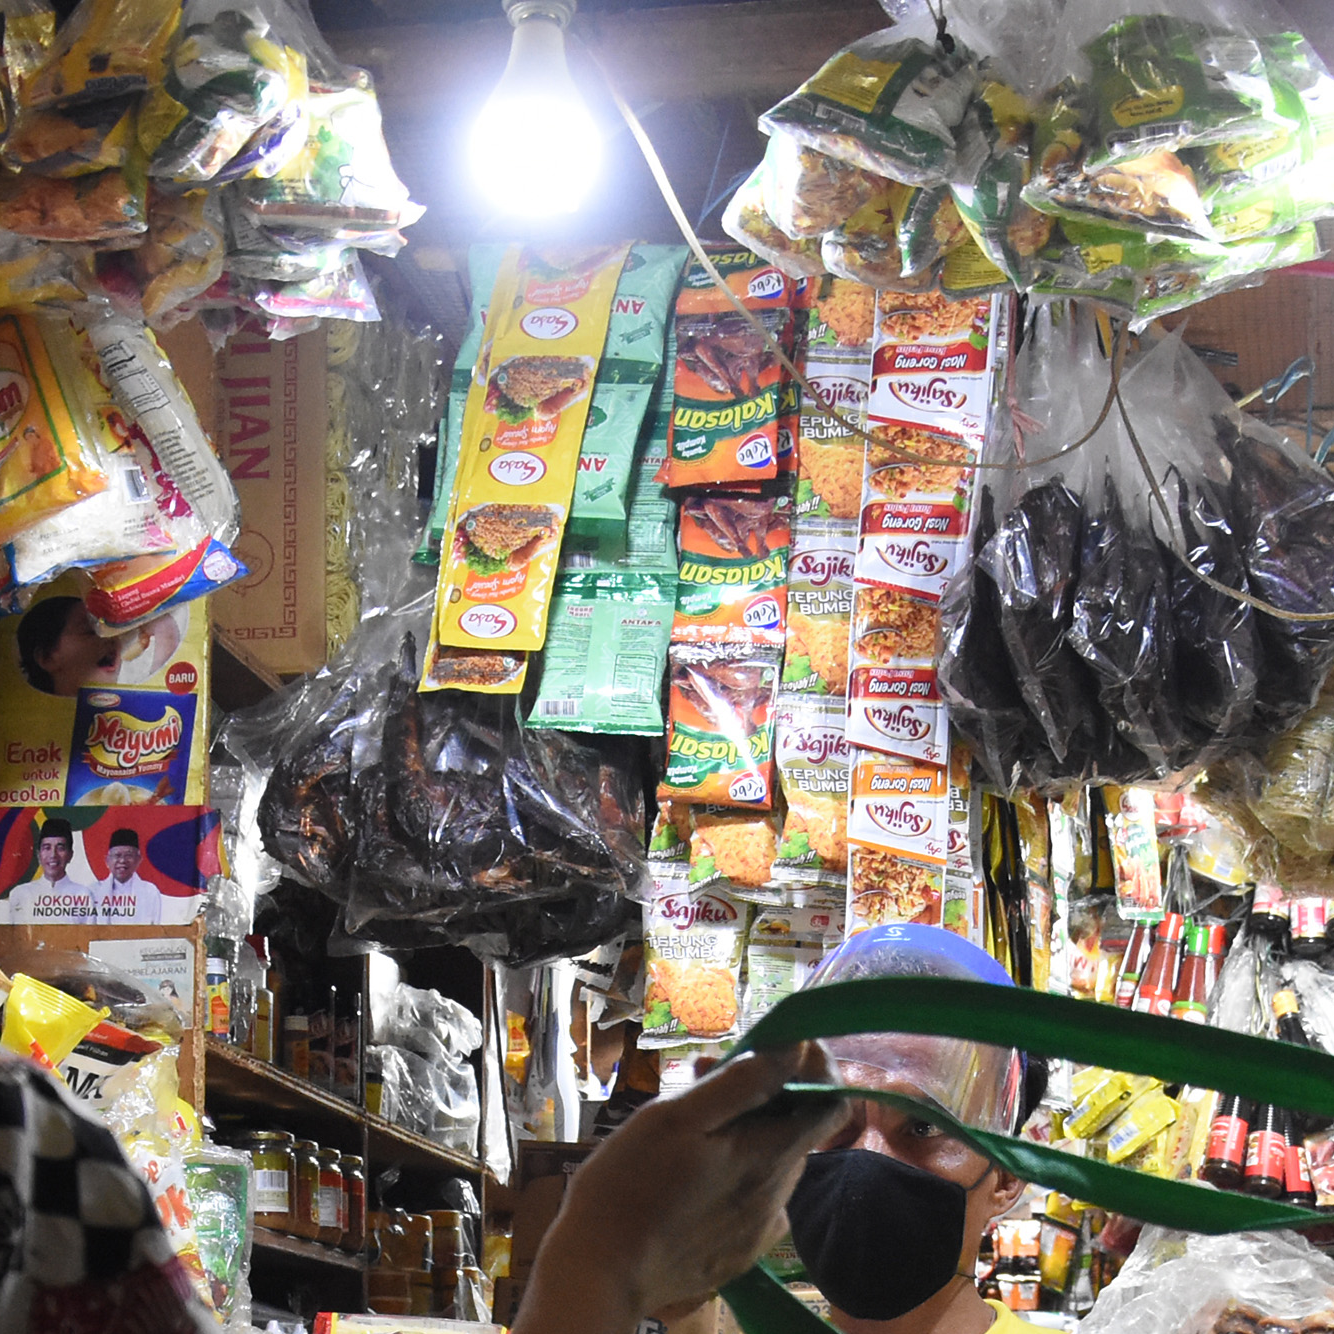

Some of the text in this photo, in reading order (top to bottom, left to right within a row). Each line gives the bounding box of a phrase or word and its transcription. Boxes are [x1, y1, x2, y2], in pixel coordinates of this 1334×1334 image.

[530, 314, 569, 335] Sasa
[894, 354, 967, 370] Nasi Goreng
[897, 377, 957, 409] Sajiku
[673, 392, 777, 432] Kalasan
[219, 376, 272, 481] JIAN
[498, 460, 537, 481] Sasa
[882, 514, 949, 532] Nasi Goreng
[885, 541, 939, 572] Sajiku
[678, 556, 786, 586] Kalasan
[797, 555, 854, 588] Sajik
[745, 603, 778, 623] Kobe
[799, 602, 852, 616] BUMB
[468, 613, 507, 635] Sasa
[168, 672, 196, 685] BARU
[868, 678, 931, 696] Nasi Goreng
[871, 704, 923, 738] Sajiku
[88, 713, 181, 767] Mayumi
[6, 741, 62, 765] Enak
[22, 768, 60, 782] untuk
[96, 761, 165, 778] Mayonnaise Yummy
[798, 779, 849, 793] BUMB
[870, 775, 932, 793] Nasi Goreng
[873, 801, 925, 834] Sajiku
[34, 895, 91, 907] JOKOWI
[101, 894, 137, 907] AMIN
[32, 906, 136, 917] INDONESIA MAJU
[661, 898, 730, 931] Sajiku
[646, 934, 719, 948] TEPUNG
